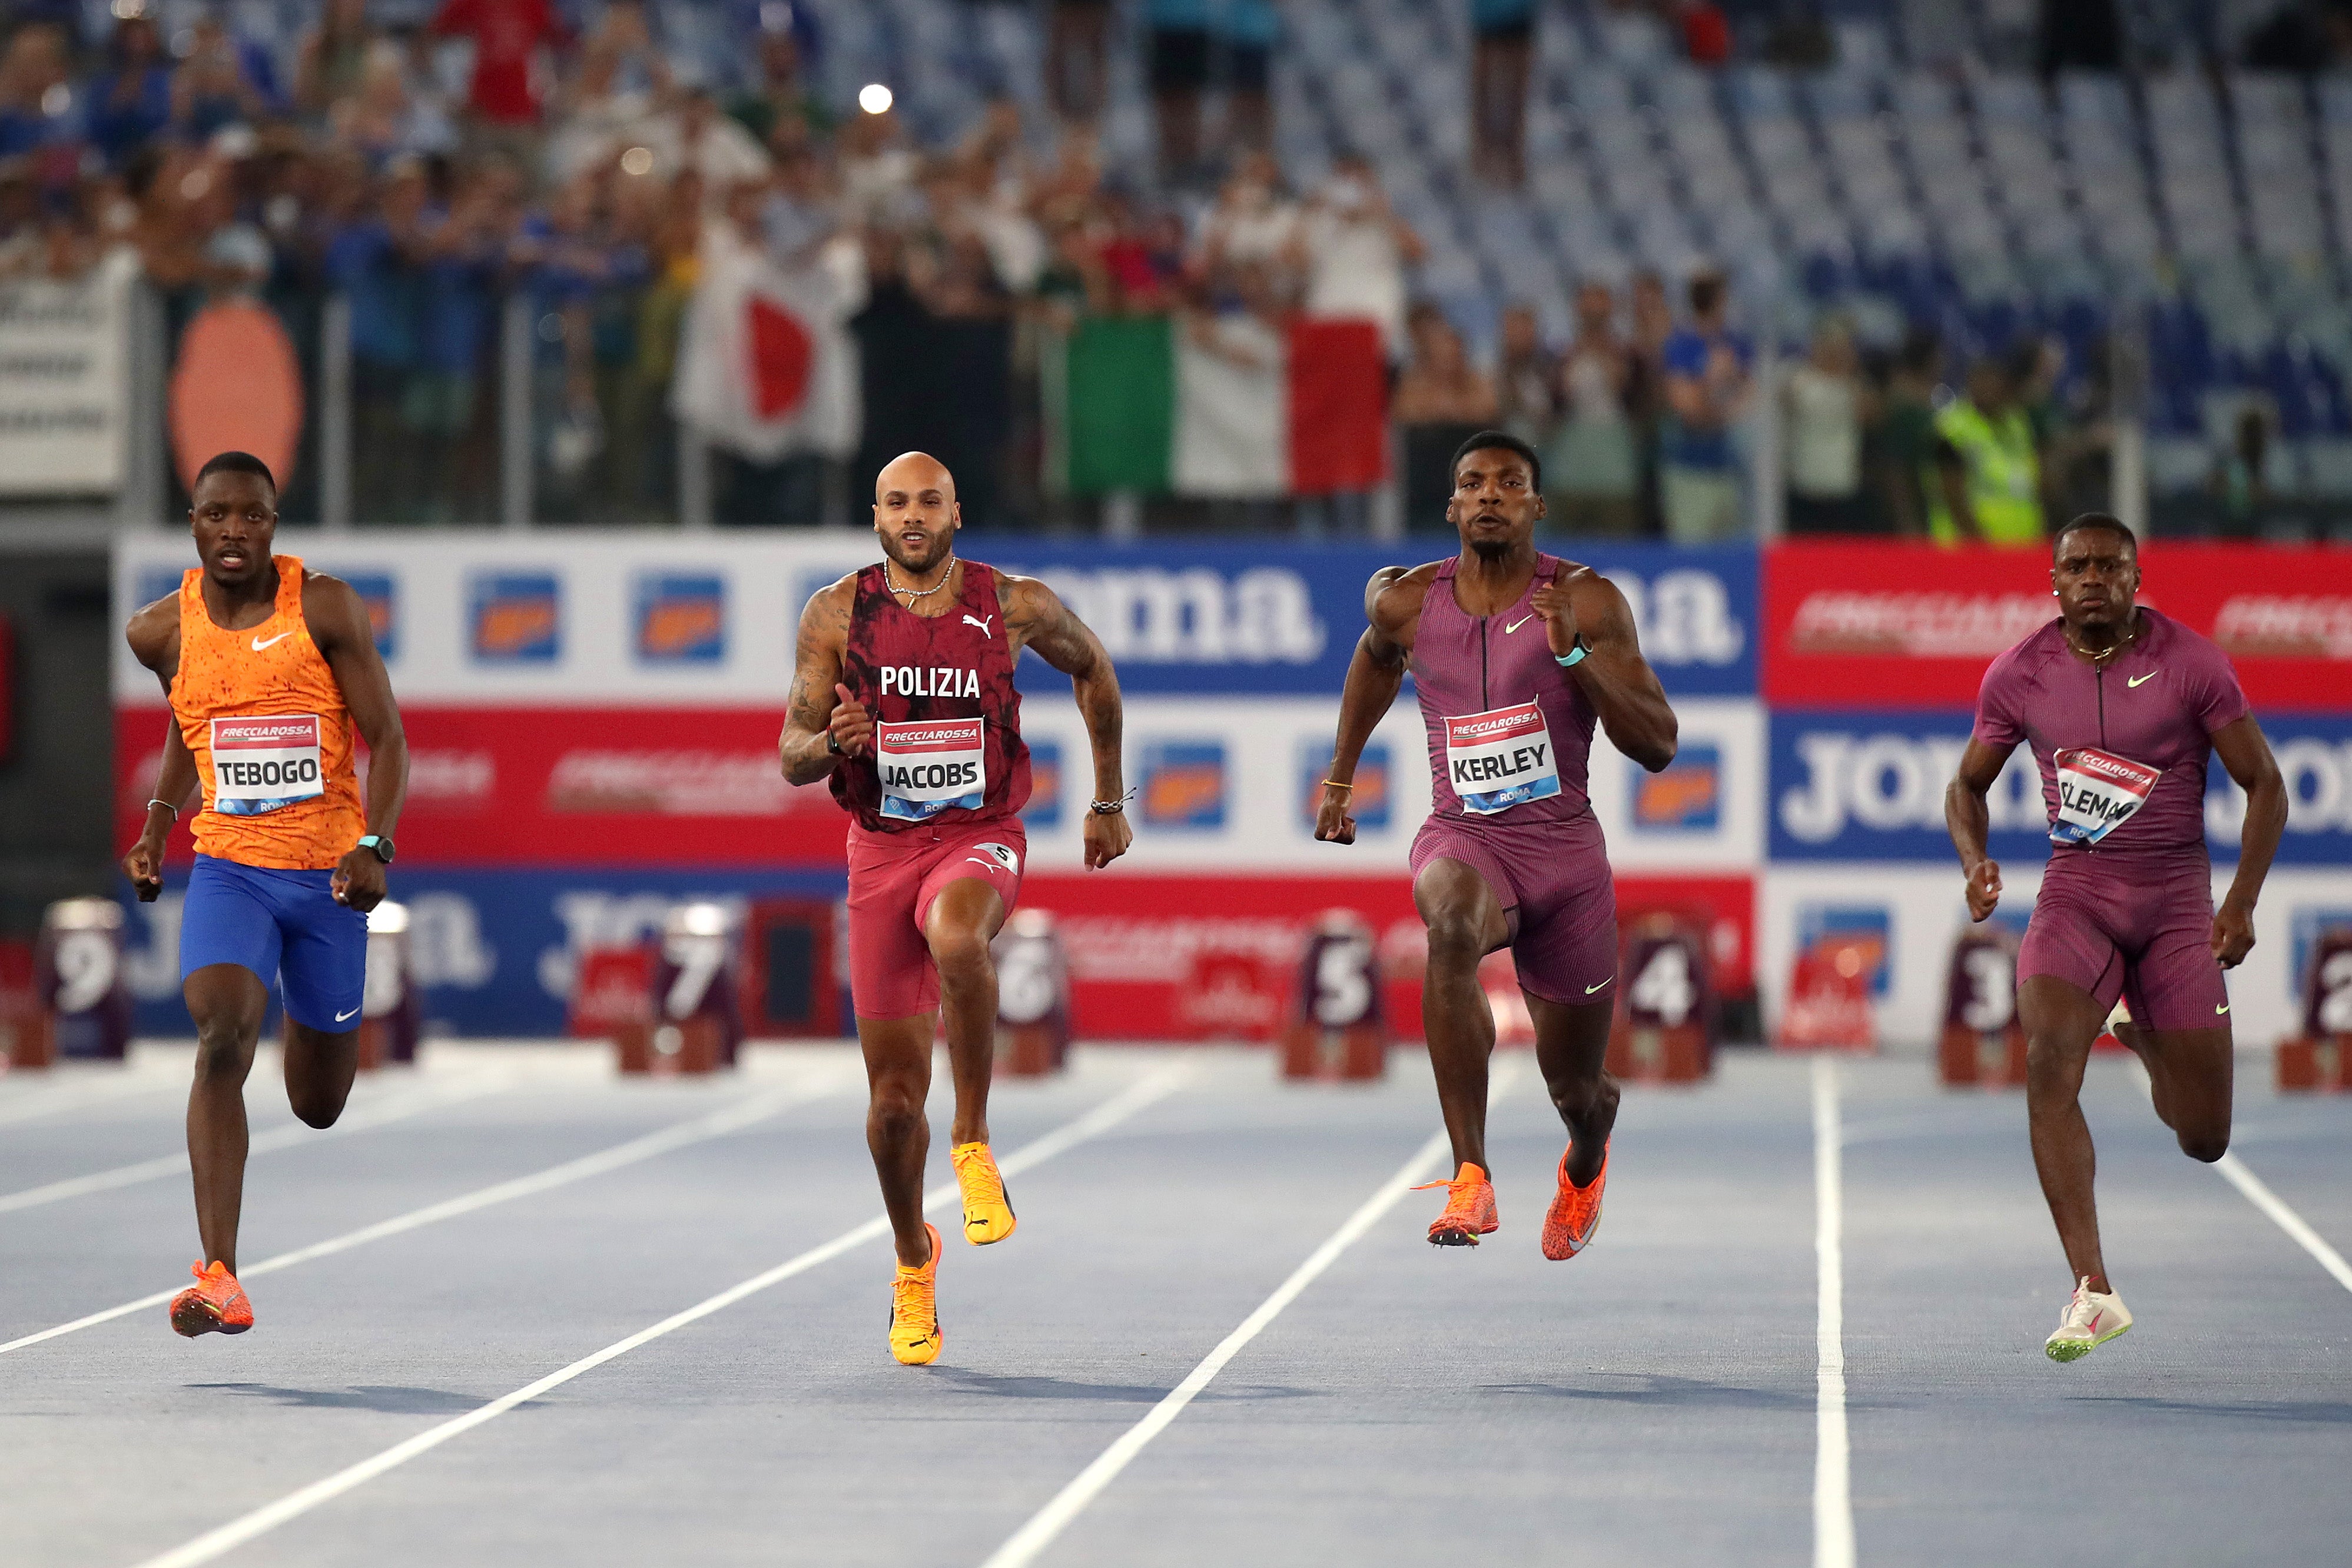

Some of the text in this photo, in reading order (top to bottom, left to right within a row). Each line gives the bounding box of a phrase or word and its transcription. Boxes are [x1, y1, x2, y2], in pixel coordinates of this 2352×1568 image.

[881, 666, 981, 699] POLIZIA
[221, 725, 312, 738] FRECCIAROSSA
[885, 729, 977, 742] FRECCIAROSSA
[1453, 712, 1539, 735] FRECCIAROSSA
[217, 758, 317, 786] TEBOGO
[885, 762, 977, 789] JACOBS
[1453, 743, 1545, 783] KERLEY
[1500, 787, 1531, 802] ROMA
[55, 930, 117, 1014] 9
[664, 938, 723, 1019] 7
[1314, 939, 1372, 1026] 5
[1630, 944, 1692, 1027] 4
[1960, 945, 2018, 1032] 3
